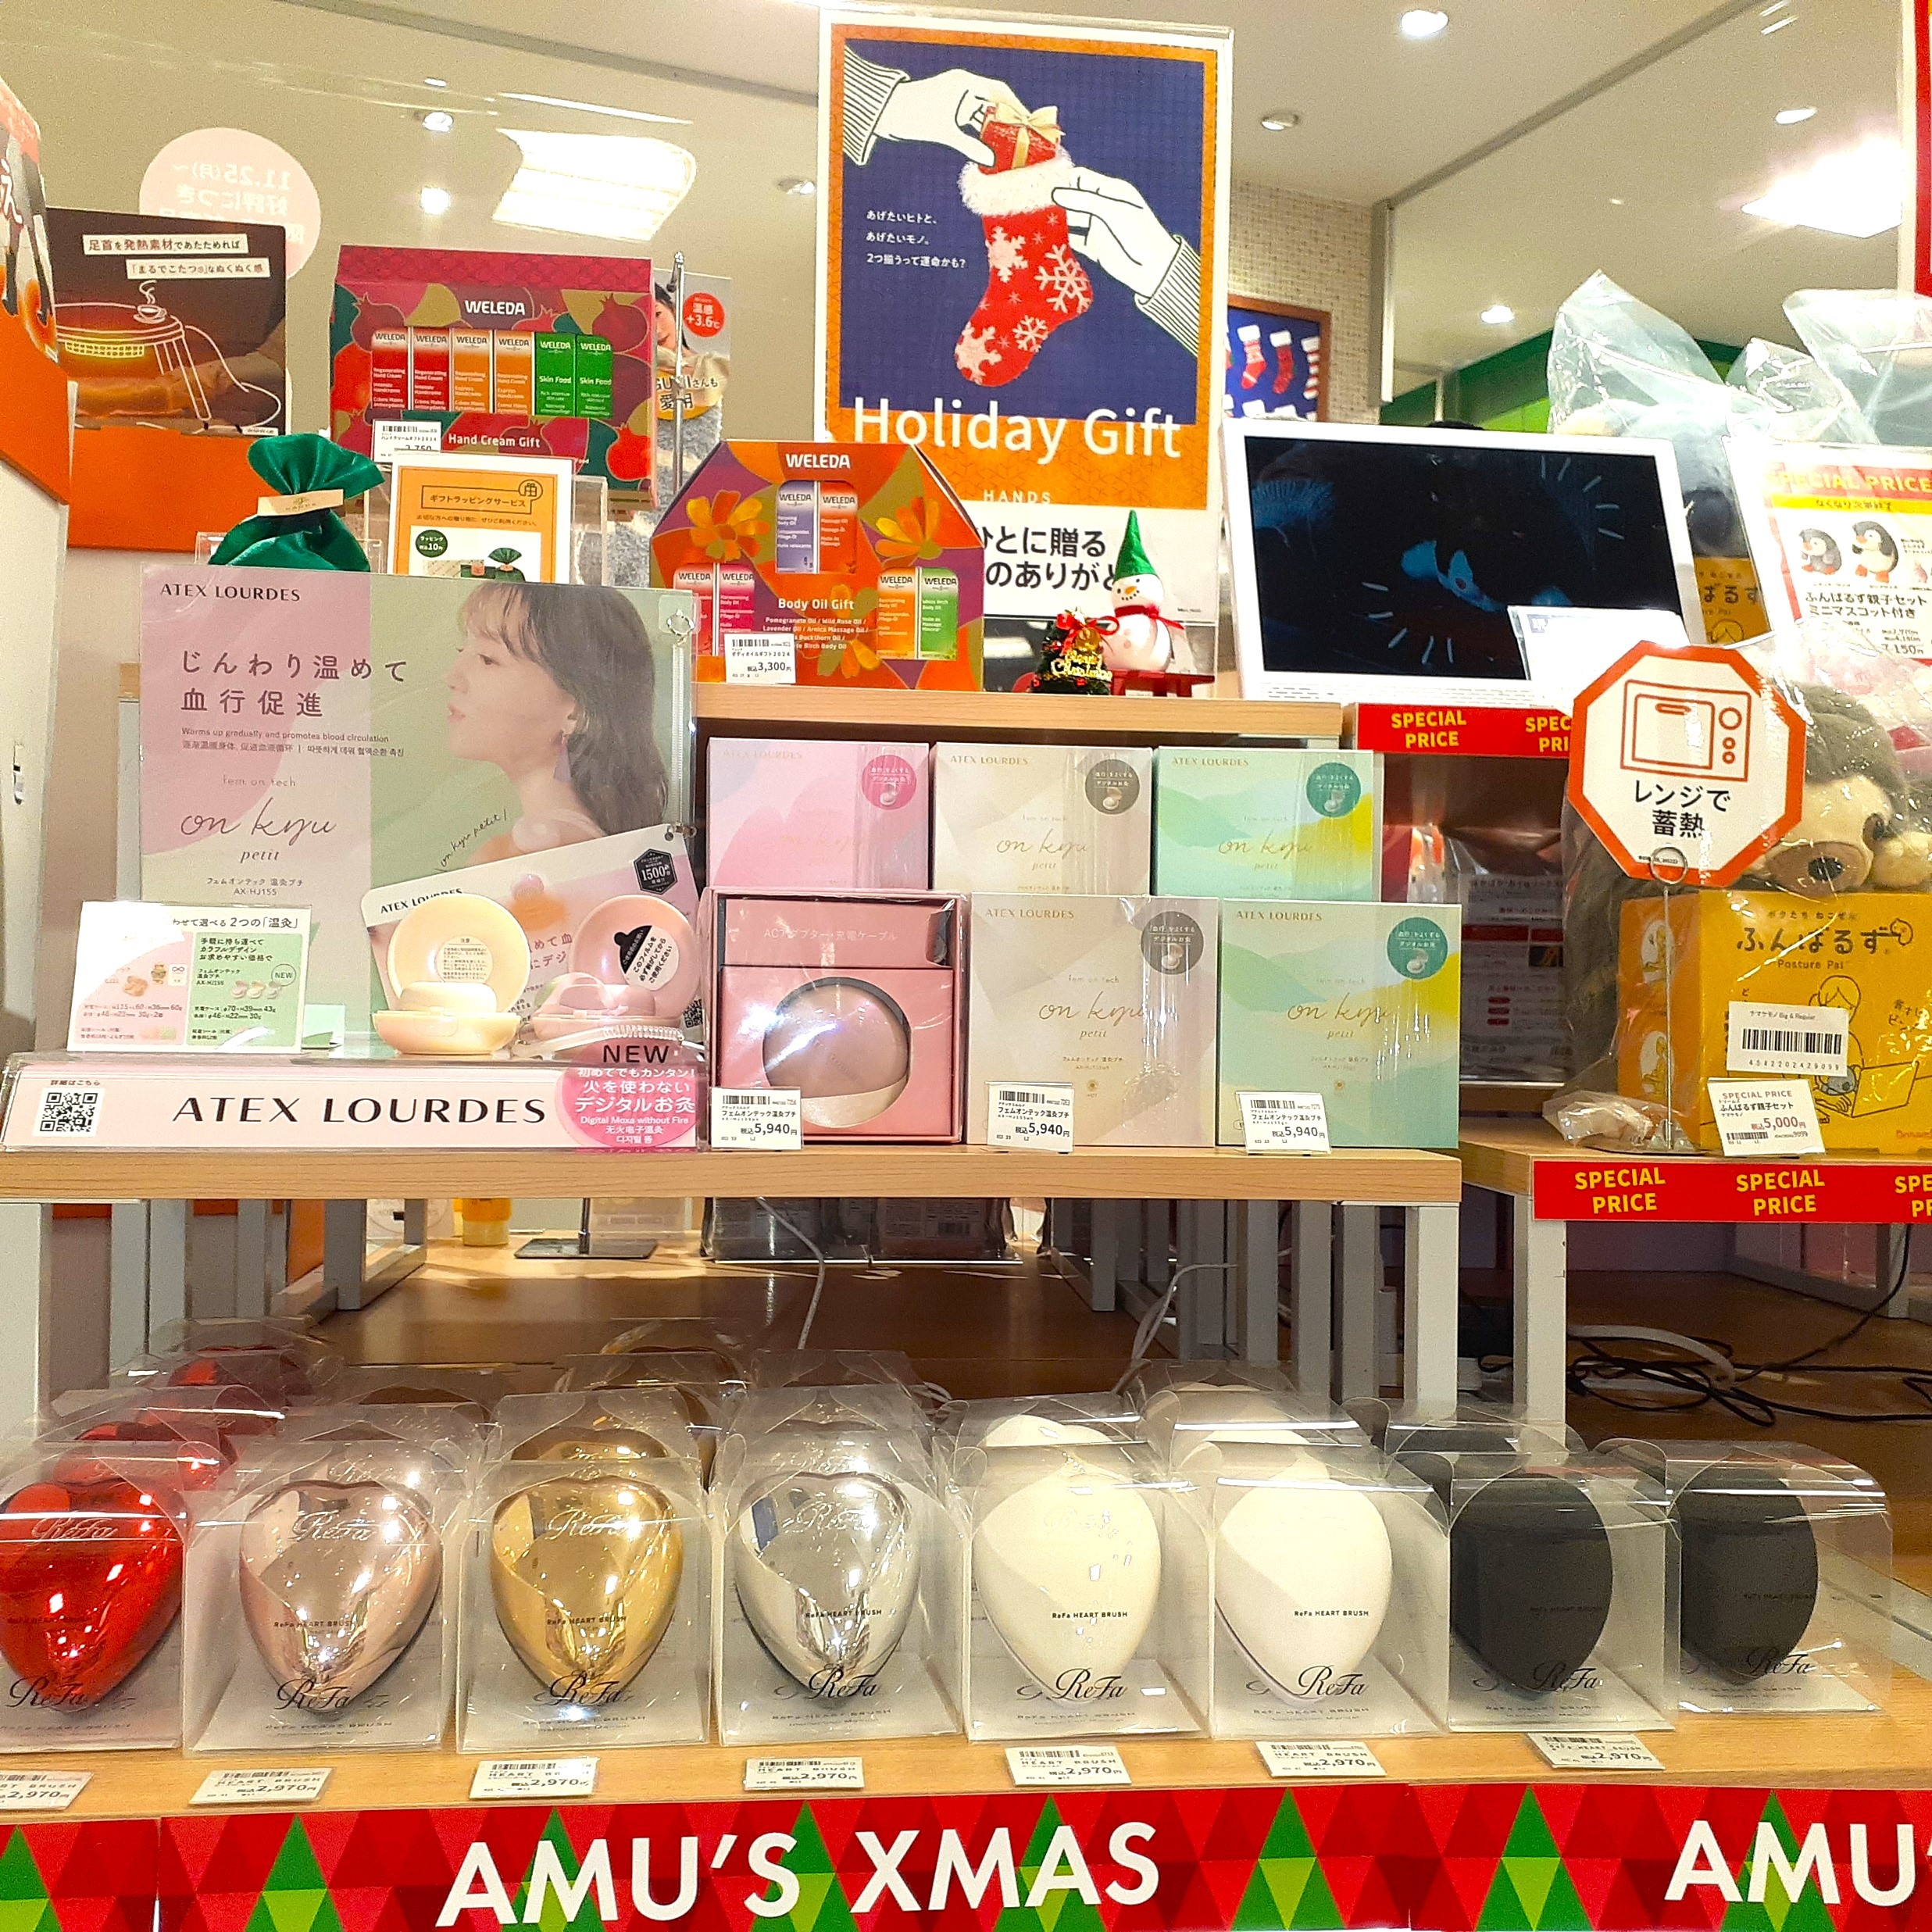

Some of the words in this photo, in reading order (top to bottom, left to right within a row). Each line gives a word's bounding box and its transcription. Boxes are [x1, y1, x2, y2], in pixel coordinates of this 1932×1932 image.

[866, 210, 937, 224] あげたいヒトと、
[866, 231, 930, 245] あげたいモノ。
[464, 300, 526, 316] WELEDA
[541, 341, 570, 349] WELEDA
[854, 397, 1066, 465] Holiday
[1084, 407, 1181, 459] Gift
[448, 434, 477, 445] Hand
[481, 434, 516, 447] Cream
[519, 437, 541, 448] Gift
[785, 454, 851, 469] WELEDA
[1865, 474, 1932, 493] PRICE
[430, 495, 526, 508] ギフトラッピングサービス
[983, 490, 1052, 504] HANDS
[161, 584, 207, 598] ATEX
[215, 585, 301, 602] LOURDES
[778, 598, 809, 610] Body
[812, 598, 828, 609] Oil
[831, 598, 855, 609] Gift
[181, 650, 407, 682] じんわり温めて
[180, 690, 323, 717] 血行促進
[1391, 710, 1466, 730] SPECIAL
[181, 727, 211, 736] Warms
[212, 730, 223, 738] up
[282, 731, 320, 741] promotes
[323, 733, 345, 741] blood
[347, 733, 389, 743] circulation
[1405, 731, 1459, 748] PRICE
[1634, 780, 1731, 812] レンジで
[180, 812, 241, 835] on
[251, 797, 337, 845] kyu
[1652, 809, 1705, 837] 蓄熱
[240, 848, 280, 863] petit
[380, 900, 409, 915] ATEX
[985, 909, 1016, 918] ATEX
[1020, 909, 1074, 920] LOURDES
[1269, 912, 1323, 922] LOURDES
[1038, 1003, 1080, 1020] on
[603, 1045, 670, 1064] NEW
[583, 1080, 690, 1094] 火を使わない
[173, 1098, 300, 1122] ATEX
[323, 1098, 545, 1123] LOURDES
[574, 1096, 696, 1113] デジタルお灸
[580, 1116, 609, 1126] Digital
[1574, 1167, 1666, 1190] SPECIAL
[1736, 1170, 1825, 1192] SPECIAL
[1592, 1192, 1658, 1213] PRICE
[1753, 1195, 1816, 1216] PRICE
[548, 1671, 622, 1705] ReFa
[807, 1666, 877, 1699] ReFa
[1048, 1666, 1127, 1701] ReFa
[1291, 1664, 1367, 1697] ReFa
[434, 1831, 801, 1928] AMU'S
[850, 1821, 1159, 1912] XMAS
